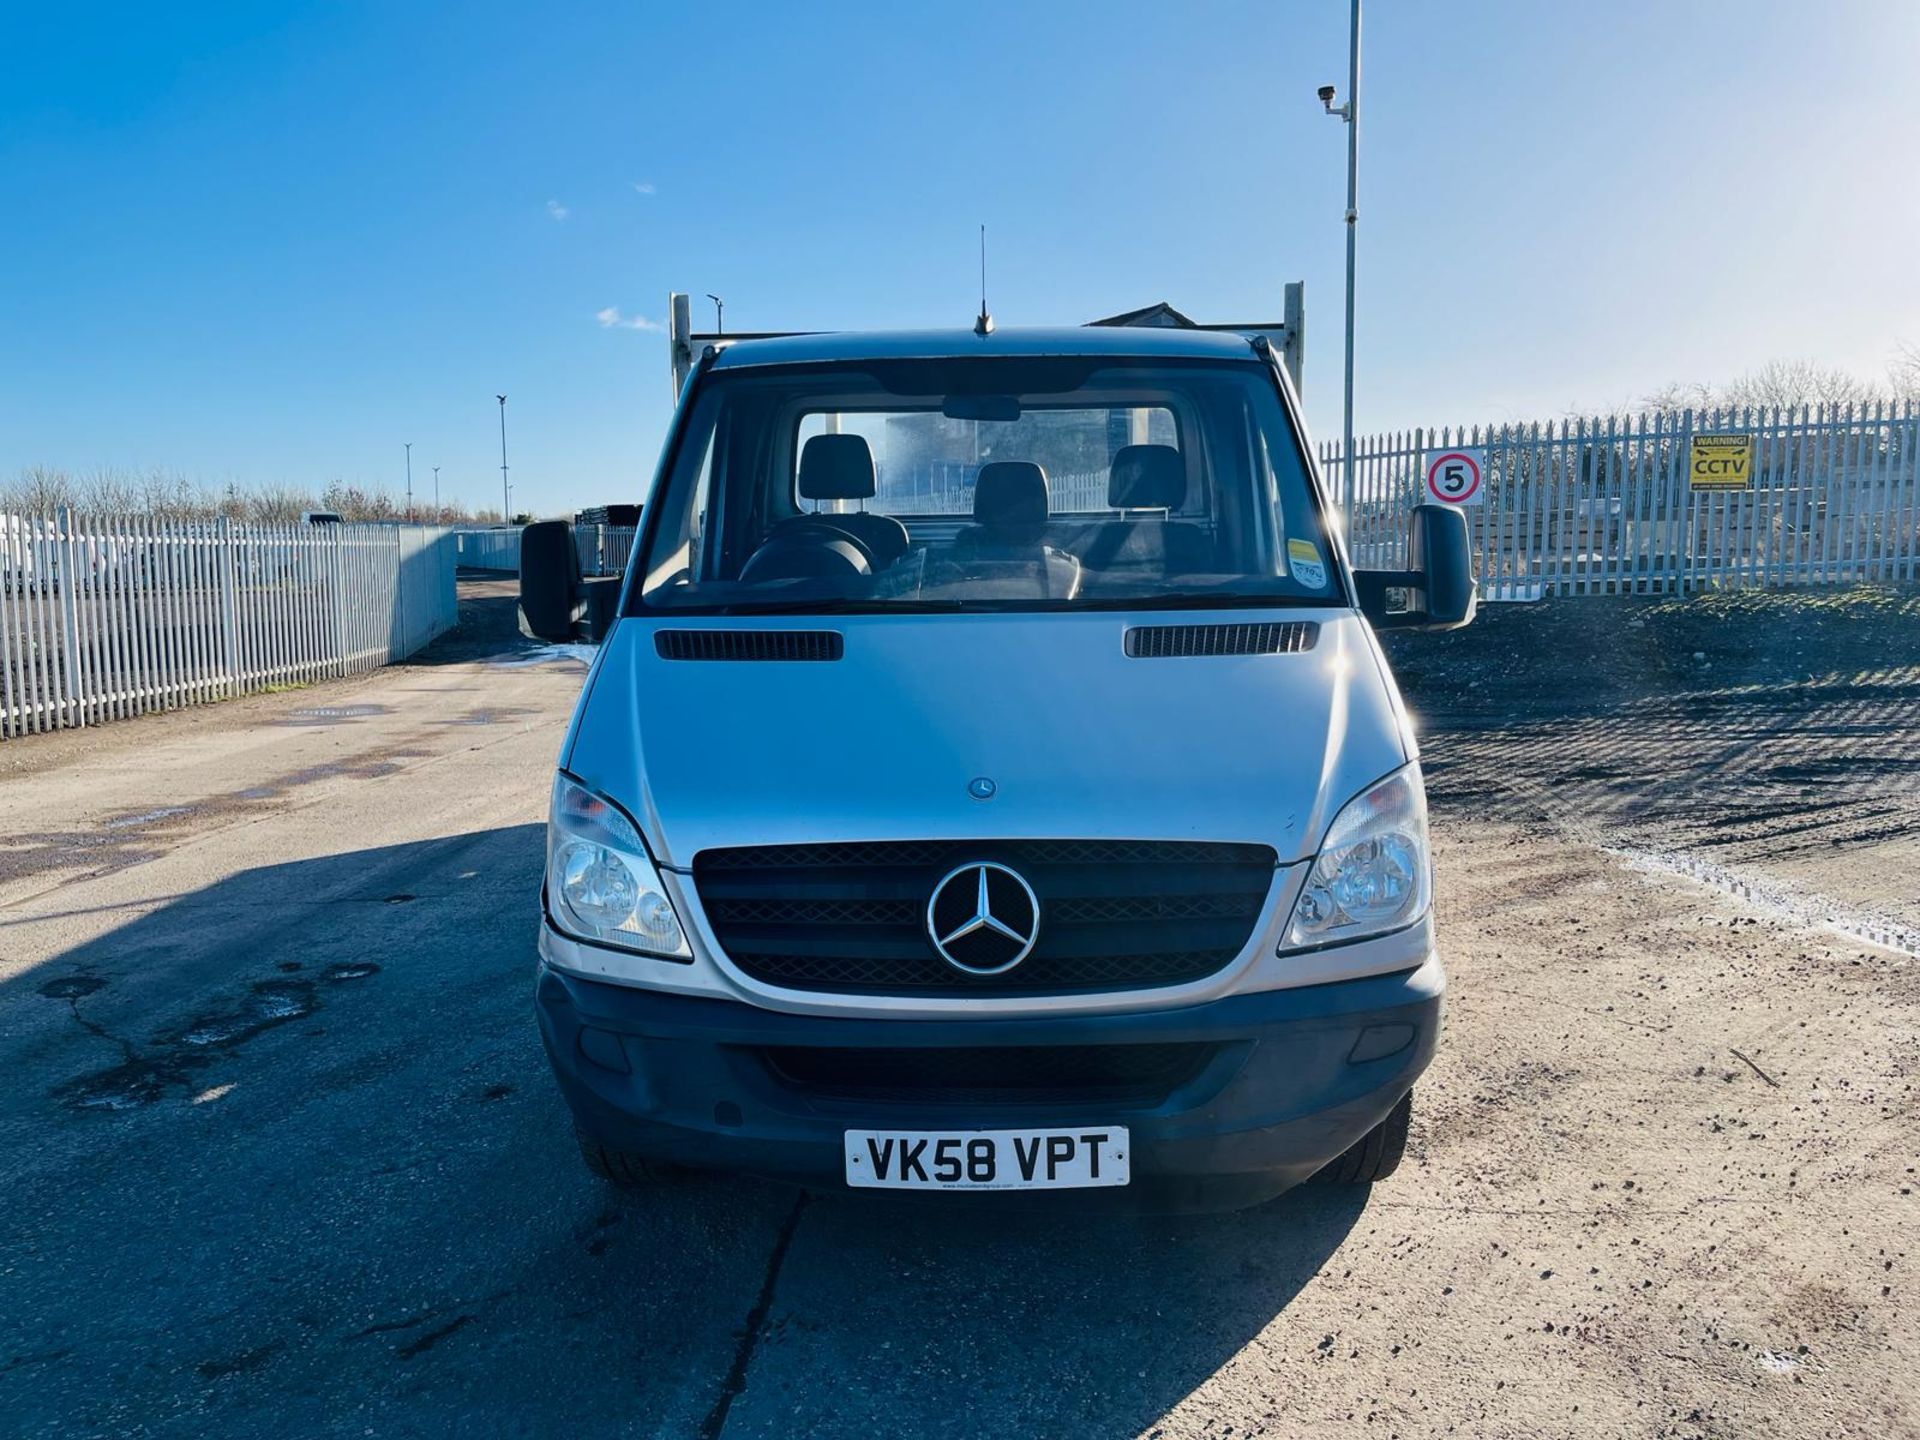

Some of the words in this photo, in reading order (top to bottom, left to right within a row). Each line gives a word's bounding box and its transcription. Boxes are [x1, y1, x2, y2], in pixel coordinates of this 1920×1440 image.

[1696, 437, 1747, 446] WARNING!
[1695, 459, 1745, 474] CCTV
[1444, 465, 1464, 492] 5
[867, 1138, 996, 1182] VK58
[1013, 1134, 1108, 1181] VPT
